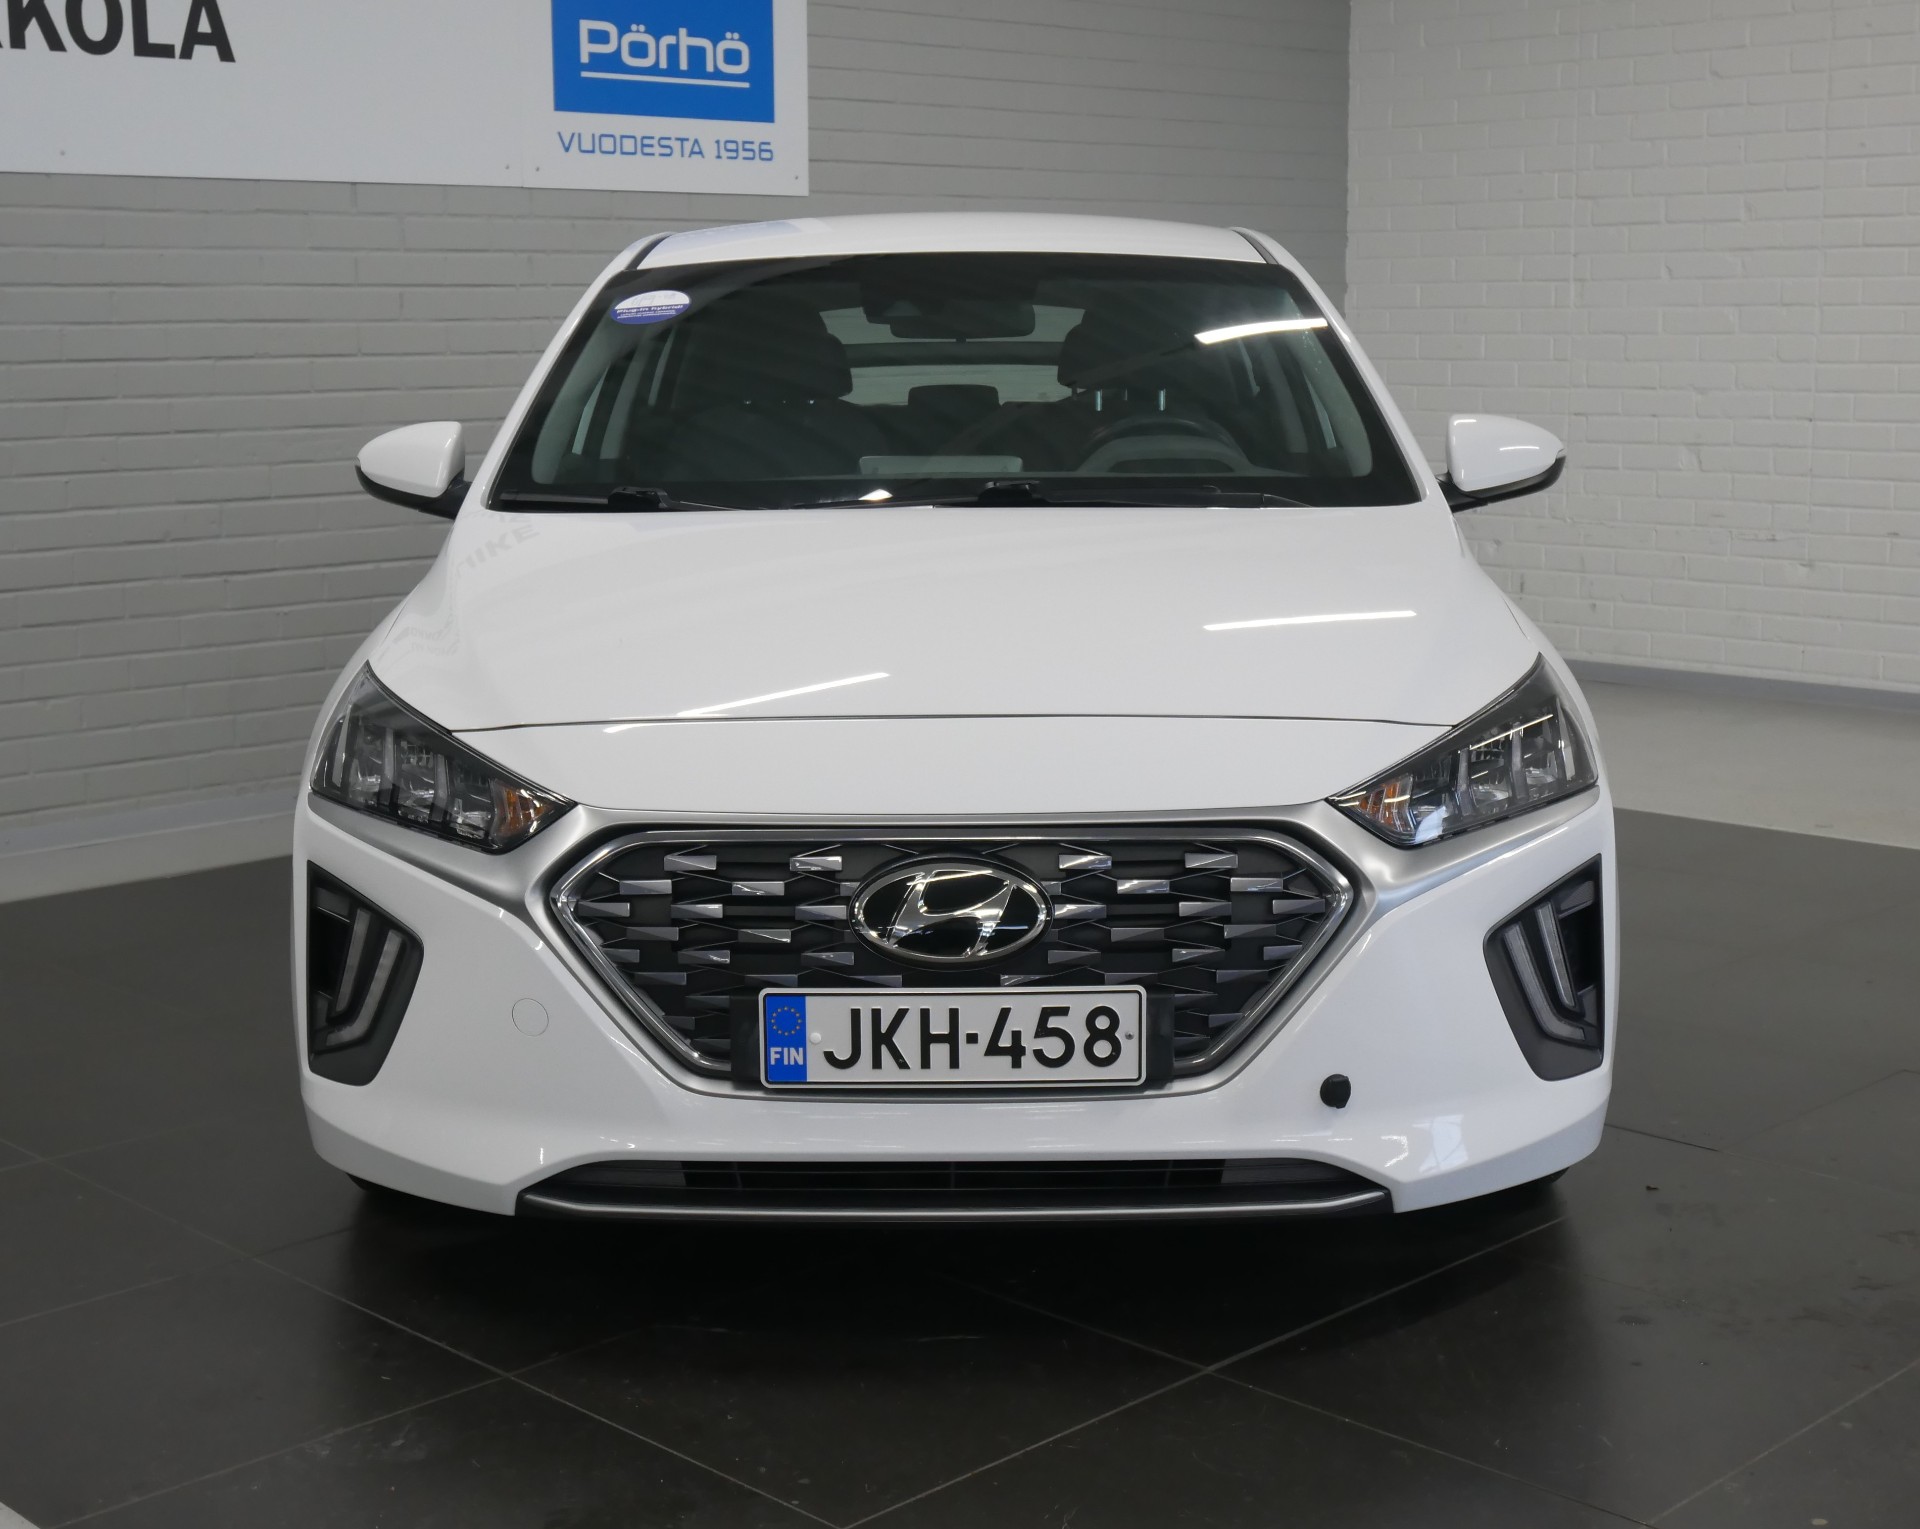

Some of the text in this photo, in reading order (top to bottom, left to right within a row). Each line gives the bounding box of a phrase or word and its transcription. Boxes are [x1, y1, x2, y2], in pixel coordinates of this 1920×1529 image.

[0, 0, 236, 63] KOLA
[579, 19, 750, 74] Pörhö
[557, 131, 774, 162] VUODESTA 1956
[770, 1047, 805, 1066] FIN
[823, 1005, 1123, 1070] JKH-458
